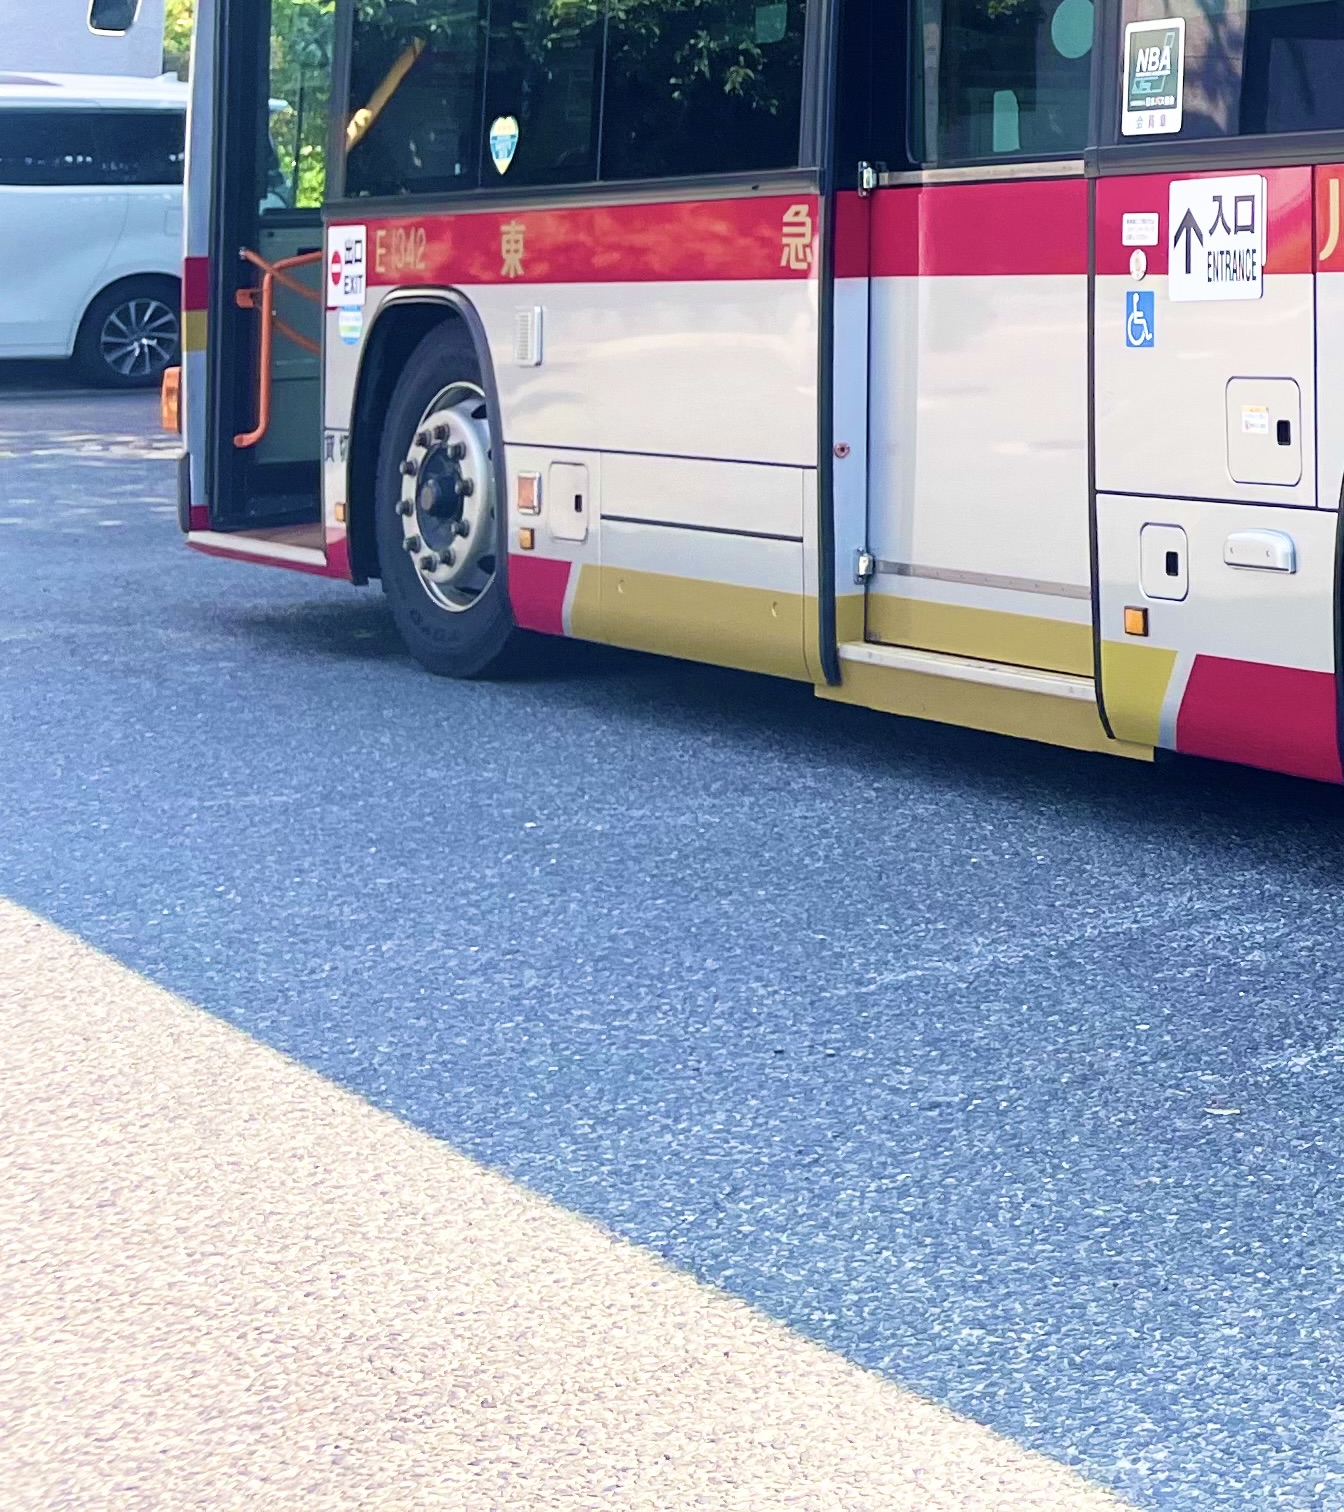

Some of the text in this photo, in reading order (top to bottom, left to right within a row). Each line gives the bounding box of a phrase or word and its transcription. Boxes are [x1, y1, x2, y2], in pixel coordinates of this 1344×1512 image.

[1136, 45, 1171, 74] NBA
[1208, 194, 1256, 236] 入口
[1207, 248, 1257, 283] ENTRANCE
[344, 273, 363, 295] EXIT
